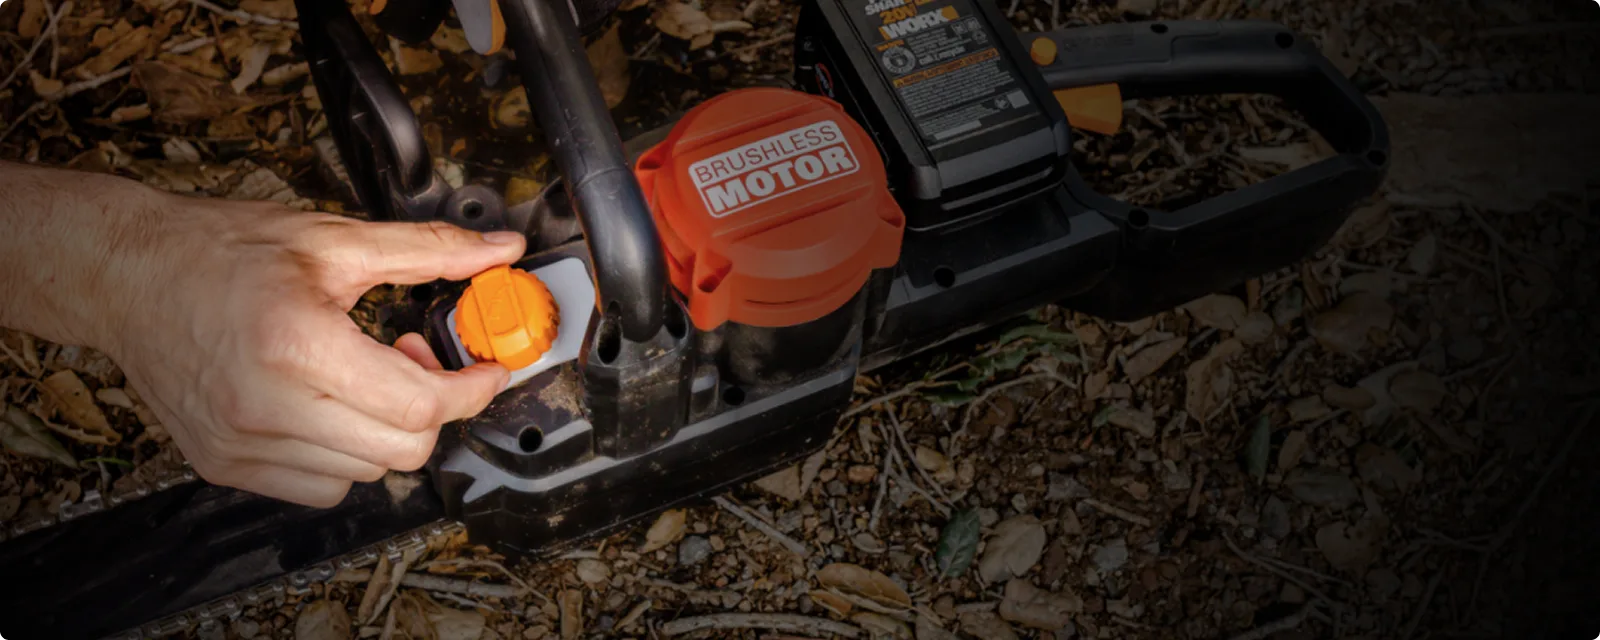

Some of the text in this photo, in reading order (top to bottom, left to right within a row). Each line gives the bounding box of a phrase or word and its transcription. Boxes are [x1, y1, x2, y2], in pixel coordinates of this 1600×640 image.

[879, 3, 917, 25] 20V
[881, 7, 950, 39] WORX
[695, 124, 838, 184] BRUSHLESS
[705, 145, 854, 213] MOTOR
